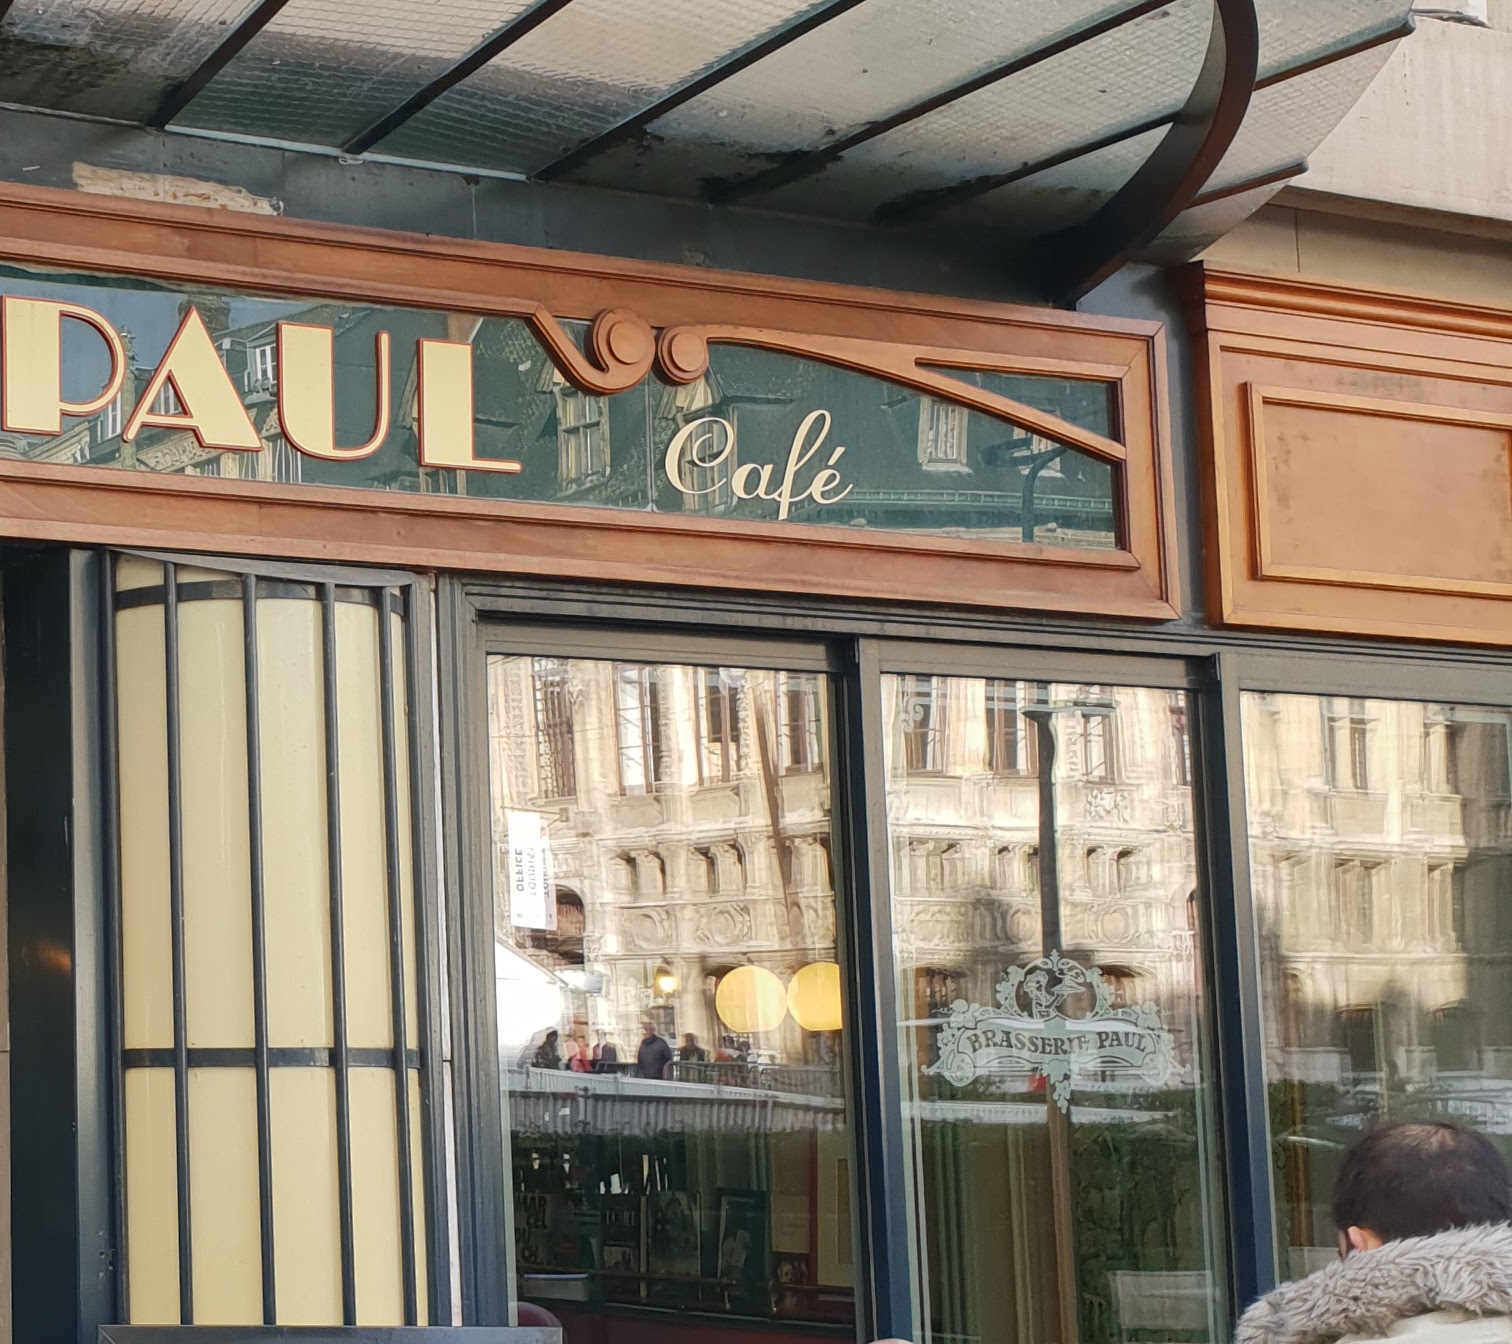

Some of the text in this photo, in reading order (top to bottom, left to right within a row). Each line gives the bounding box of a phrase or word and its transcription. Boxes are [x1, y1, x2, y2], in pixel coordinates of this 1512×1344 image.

[0, 293, 523, 474] PAUL
[665, 409, 854, 521] Café
[967, 1029, 1146, 1055] BRASSERIE PAUL
